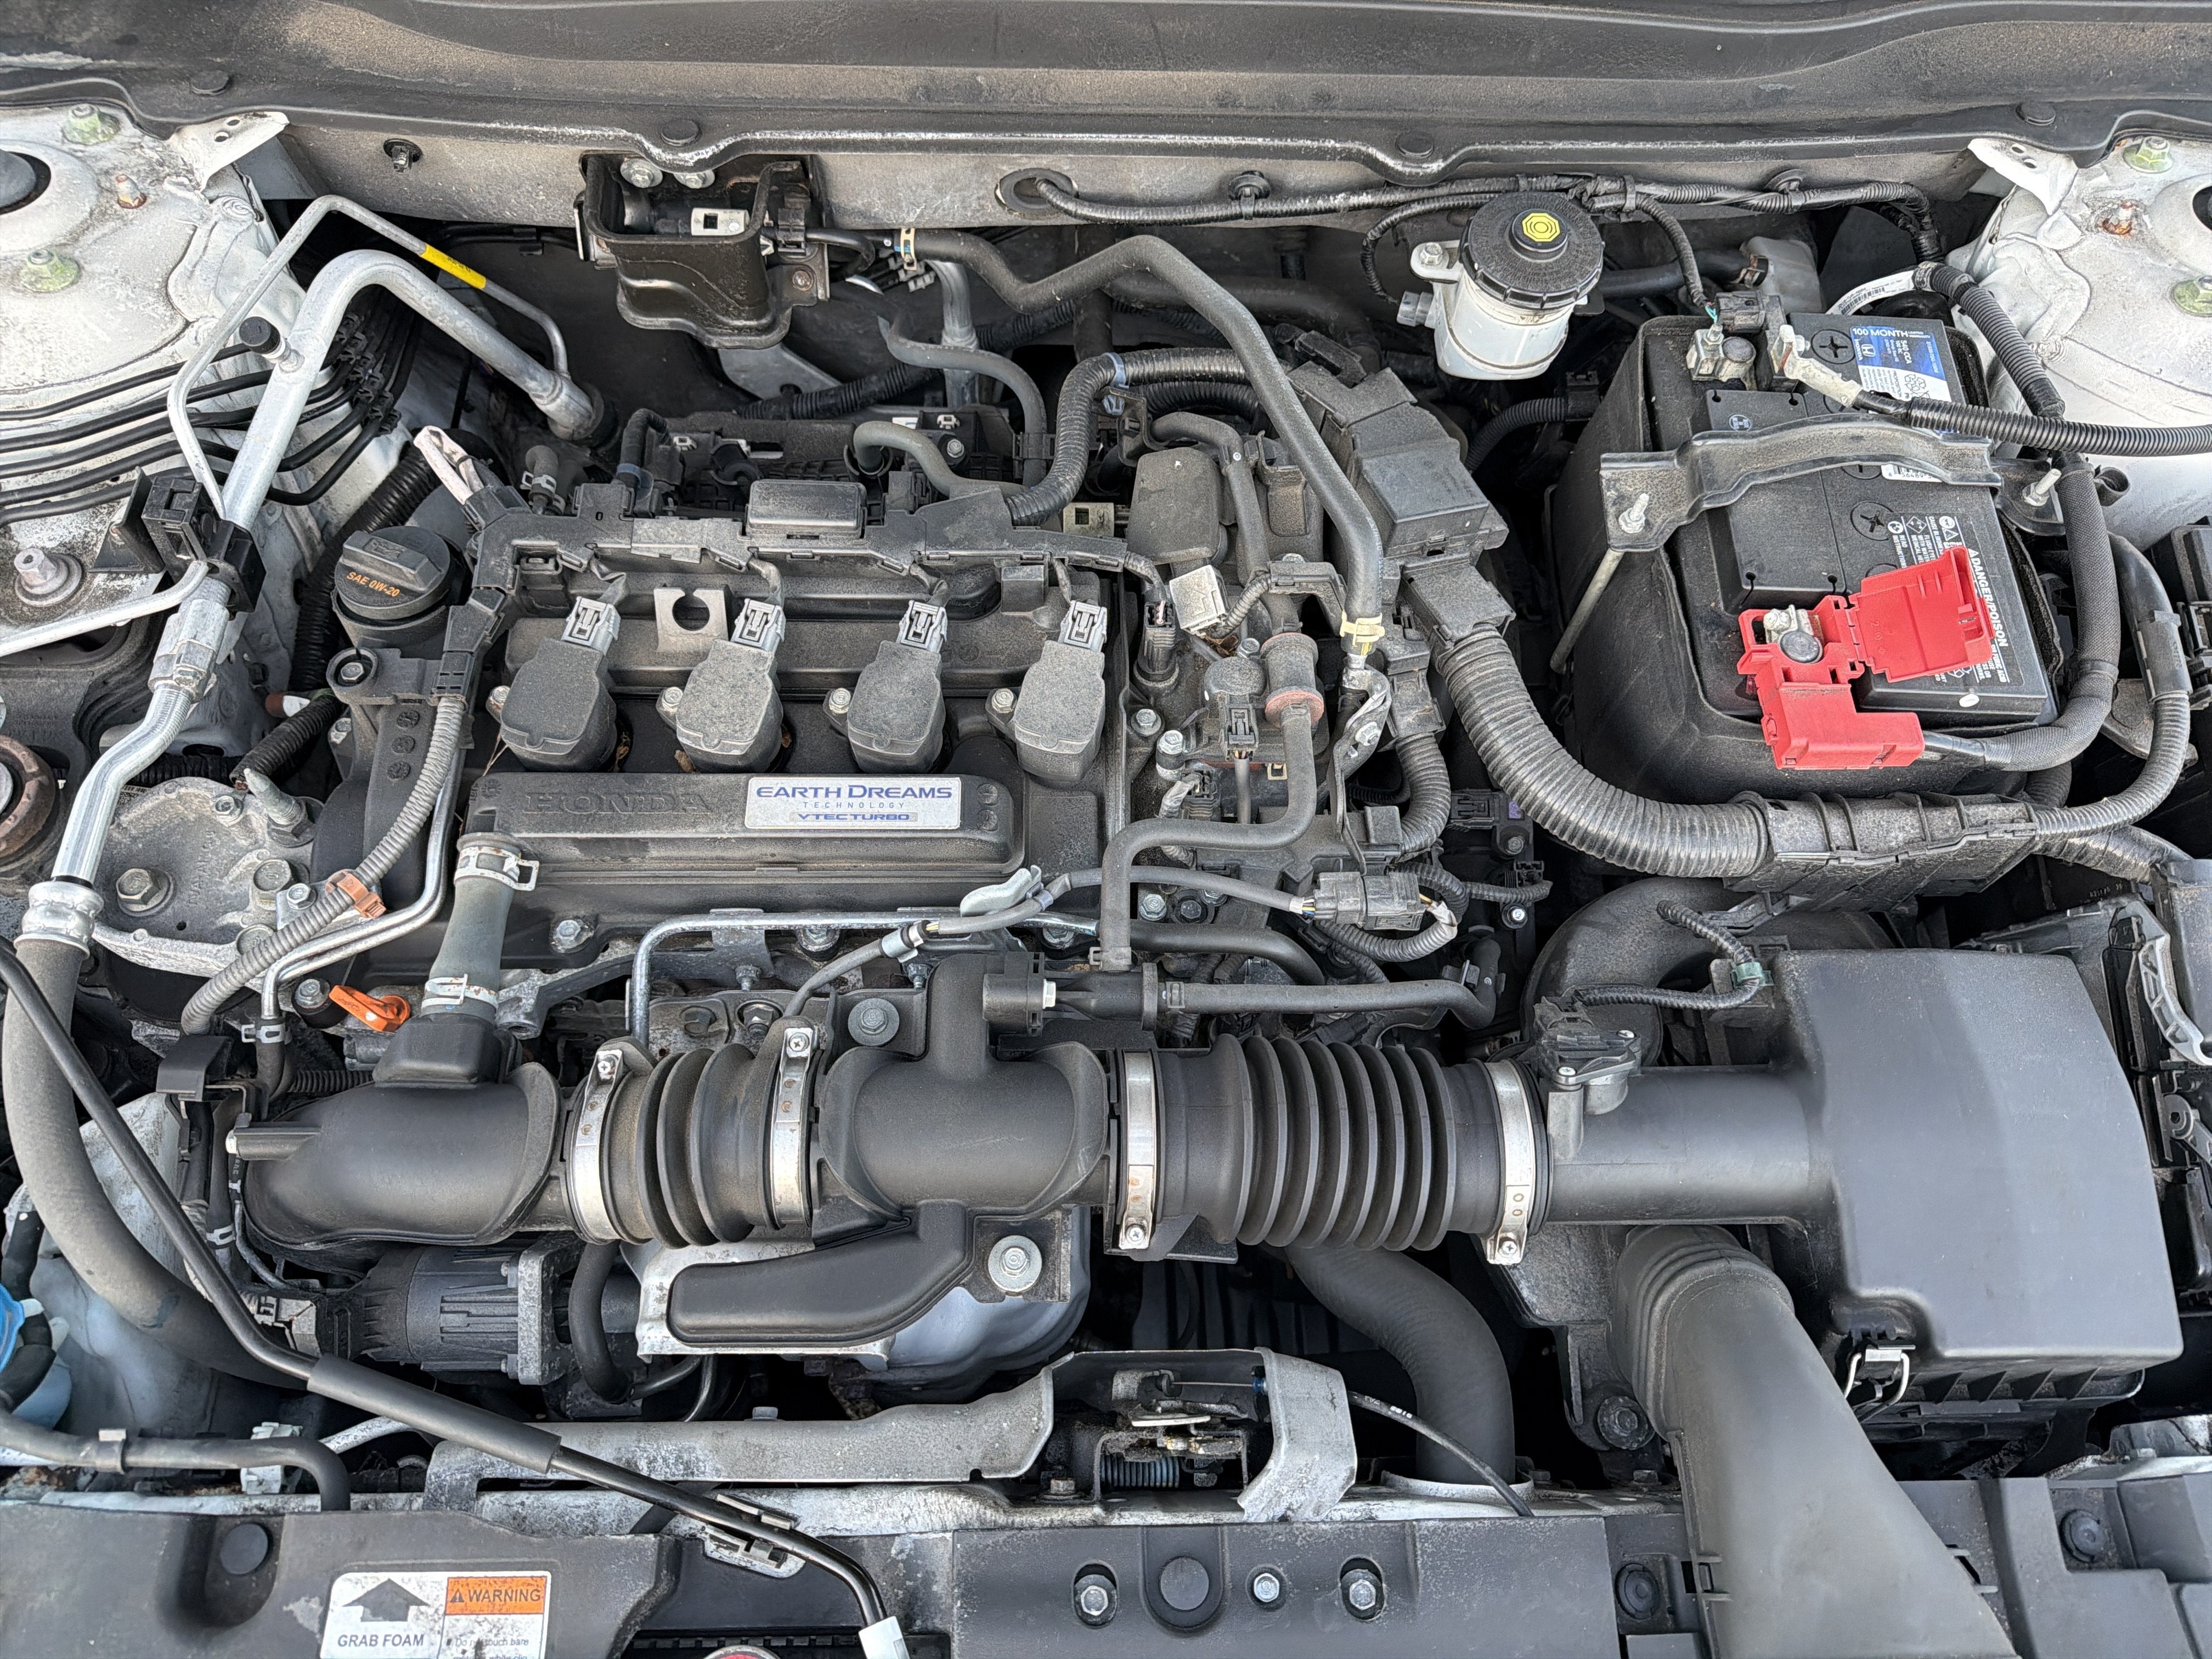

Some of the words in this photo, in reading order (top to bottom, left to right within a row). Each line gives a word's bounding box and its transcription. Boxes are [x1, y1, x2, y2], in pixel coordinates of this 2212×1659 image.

[1870, 329, 1909, 337] MONTH
[1854, 338, 1863, 360] HONDA
[1900, 340, 1909, 351] 540
[1903, 351, 1912, 364] CCA
[1928, 516, 1939, 530] CAUSE
[1899, 534, 1908, 548] READ
[1910, 534, 1921, 555] MEDICAL
[1917, 534, 1926, 547] WITH
[1923, 534, 1933, 549] FLUSH
[1892, 535, 1908, 568] INSTRUCTIONS
[346, 571, 370, 586] SAE
[368, 579, 400, 597] 0W-20
[1972, 557, 2008, 647] DANGER/POISON
[1997, 669, 2007, 682] ACID
[757, 786, 842, 798] EARTH
[848, 785, 952, 799] DREAMS
[523, 792, 715, 815] HONDA
[467, 1588, 541, 1603] WARNING
[337, 1634, 380, 1647] GRAB
[382, 1634, 425, 1646] FOAM
[510, 1637, 529, 1646] bare
